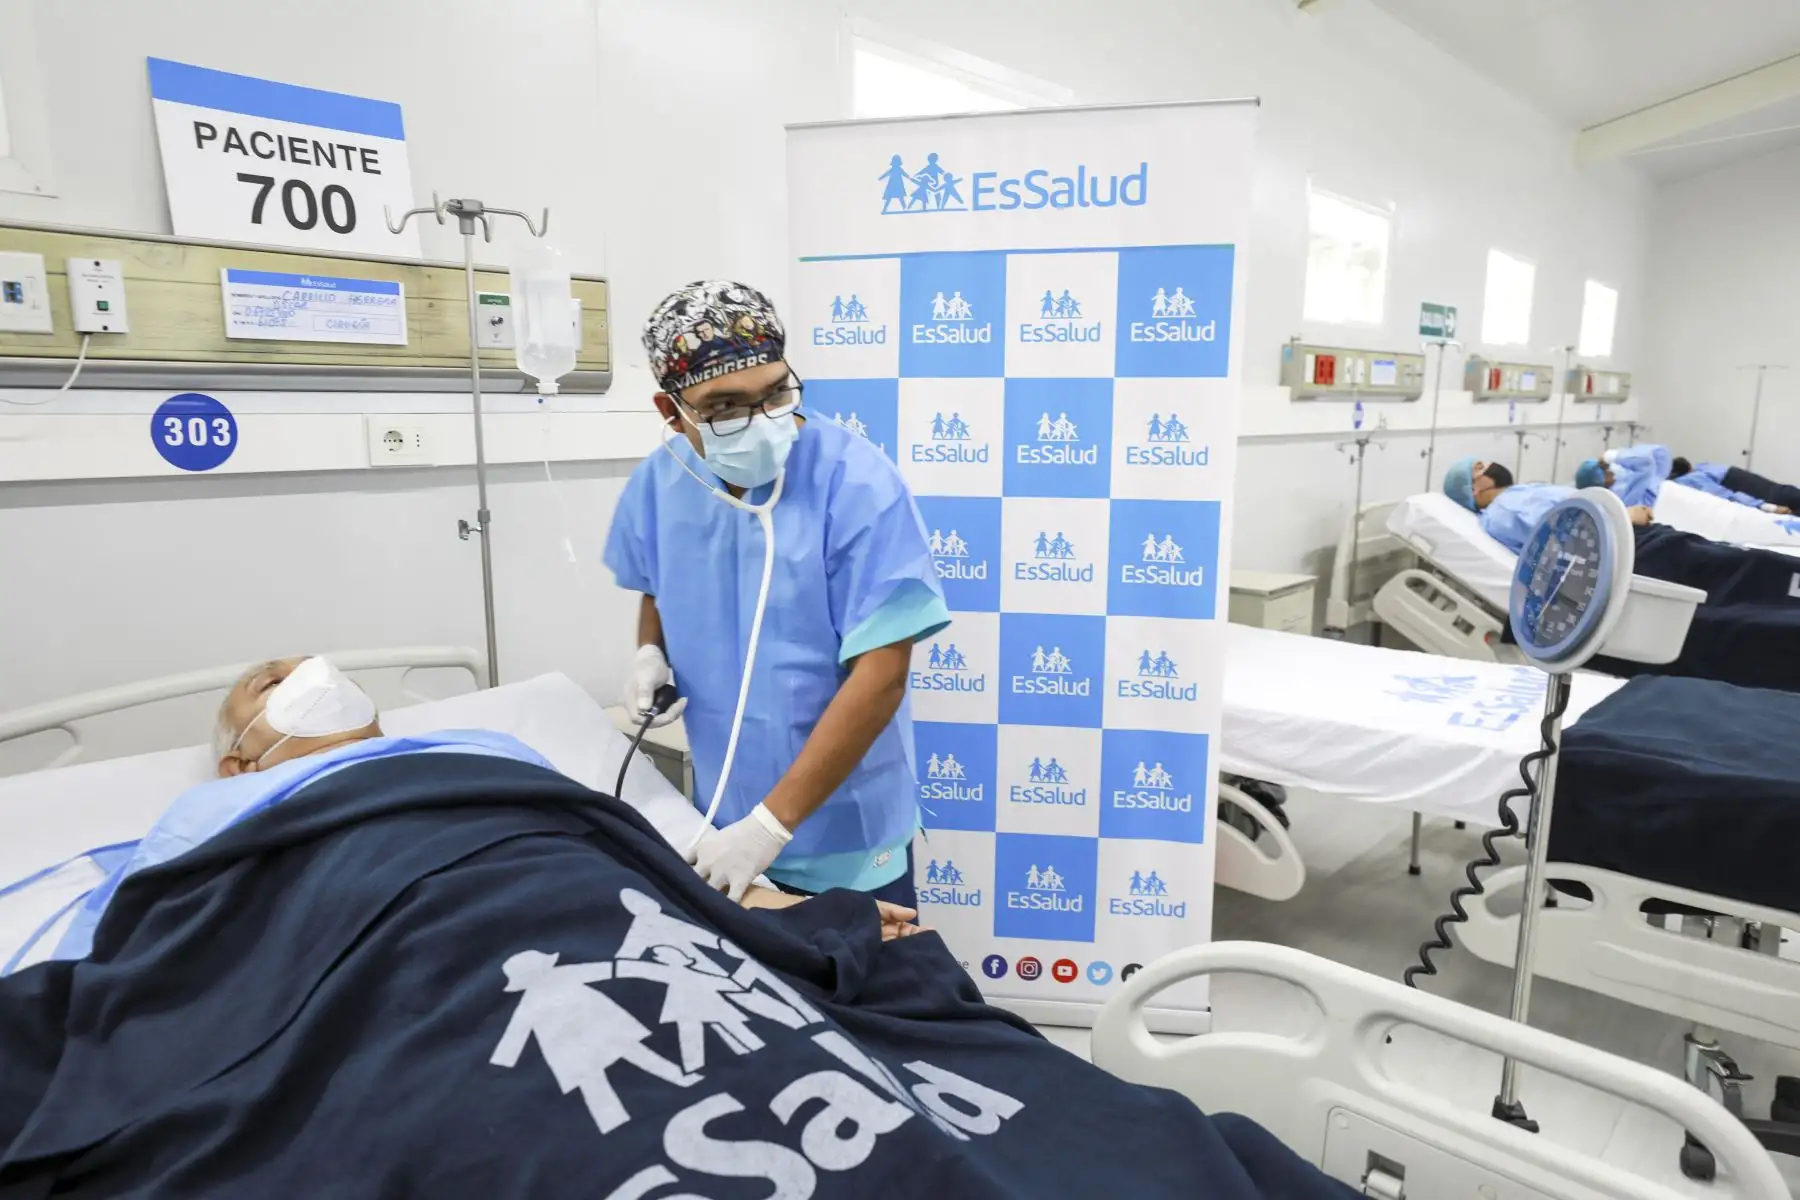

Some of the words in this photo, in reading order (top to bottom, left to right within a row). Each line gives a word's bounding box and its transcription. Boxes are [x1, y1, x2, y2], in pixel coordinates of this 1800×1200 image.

[193, 121, 382, 175] PACIENTE
[971, 162, 1148, 211] EsSalud
[237, 172, 357, 234] 700
[813, 325, 886, 346] EsSalud
[912, 321, 991, 344] EsSalud
[1020, 321, 1101, 343] EsSalud
[1130, 320, 1215, 343] EsSalud
[164, 416, 231, 447] 303
[911, 443, 989, 464] EsSalud
[1017, 444, 1098, 465] EsSalud
[1126, 445, 1209, 467] EsSalud
[934, 559, 987, 580] Salud
[1014, 562, 1093, 583] EsSalud
[1121, 564, 1203, 587] EsSalud
[910, 671, 985, 692] EsSalud
[1012, 676, 1090, 697] EsSalud
[1118, 680, 1197, 701] EsSalud
[920, 780, 983, 802] sSalud
[1010, 785, 1086, 806] EsSalud
[1113, 790, 1191, 813] EsSalud
[1007, 891, 1083, 913] EsSalud
[1109, 898, 1186, 918] EsSalud
